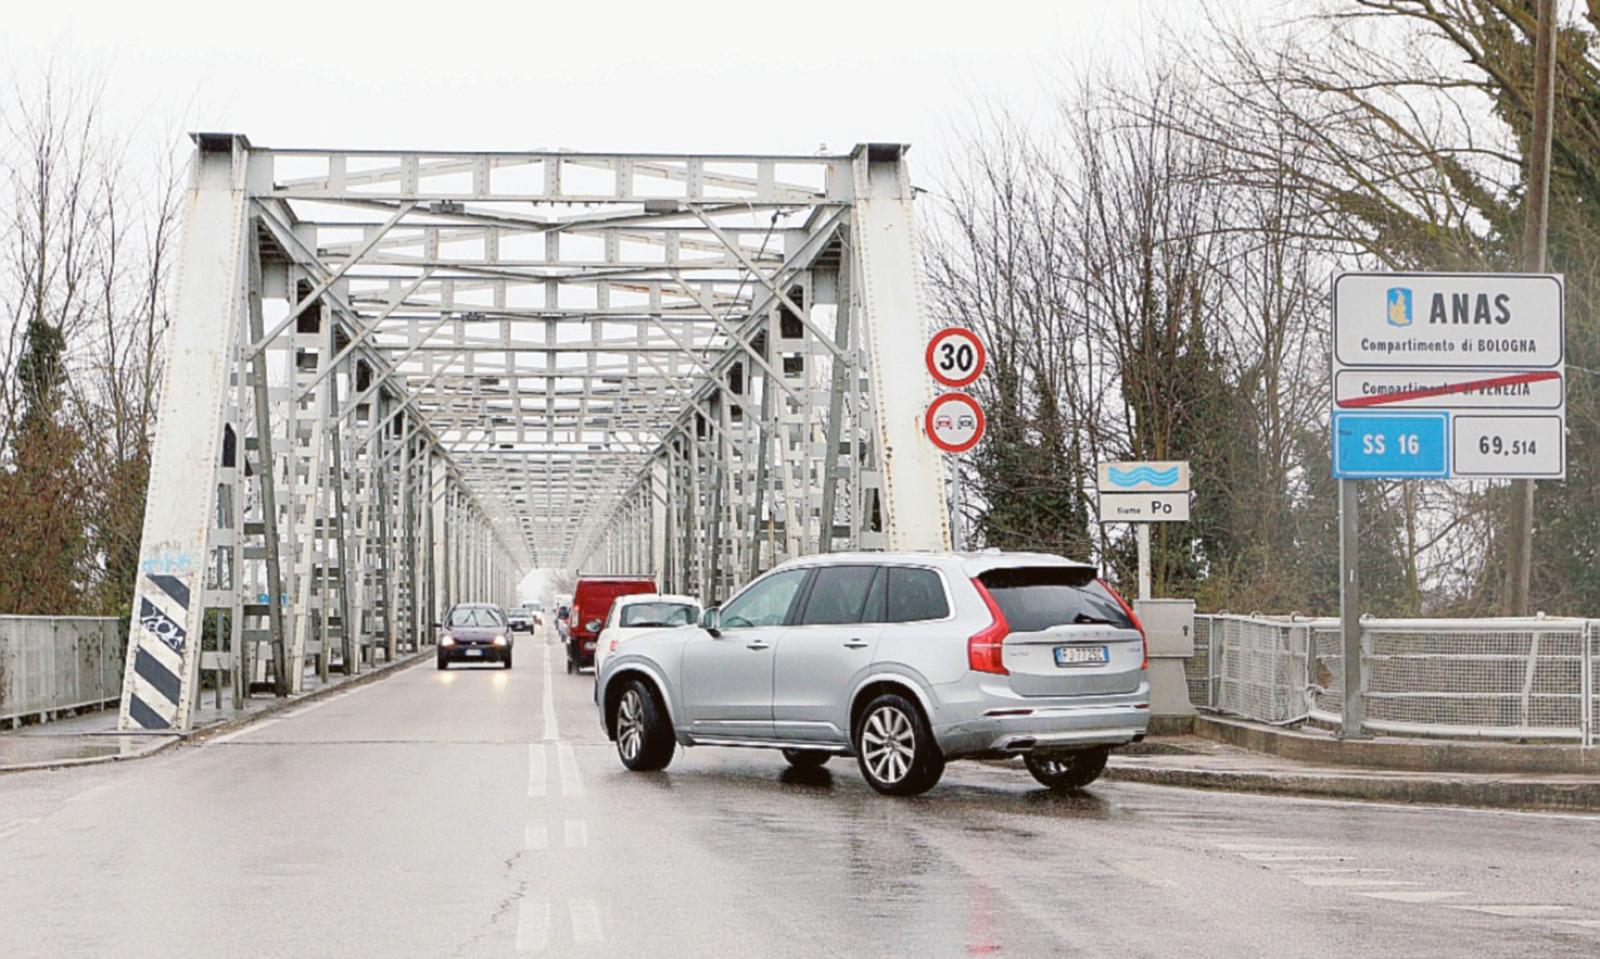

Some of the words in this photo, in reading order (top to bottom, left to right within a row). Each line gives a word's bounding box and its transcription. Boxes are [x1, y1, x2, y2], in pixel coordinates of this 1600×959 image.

[1429, 292, 1511, 325] ANAS
[1361, 338, 1455, 354] Compartimento
[1461, 339, 1473, 352] di
[1478, 340, 1536, 352] BOLOGNA
[940, 343, 974, 371] 30
[1362, 382, 1456, 397] Compartim
[1363, 434, 1385, 454] SS
[1398, 434, 1419, 454] 16
[1151, 500, 1172, 514] Po
